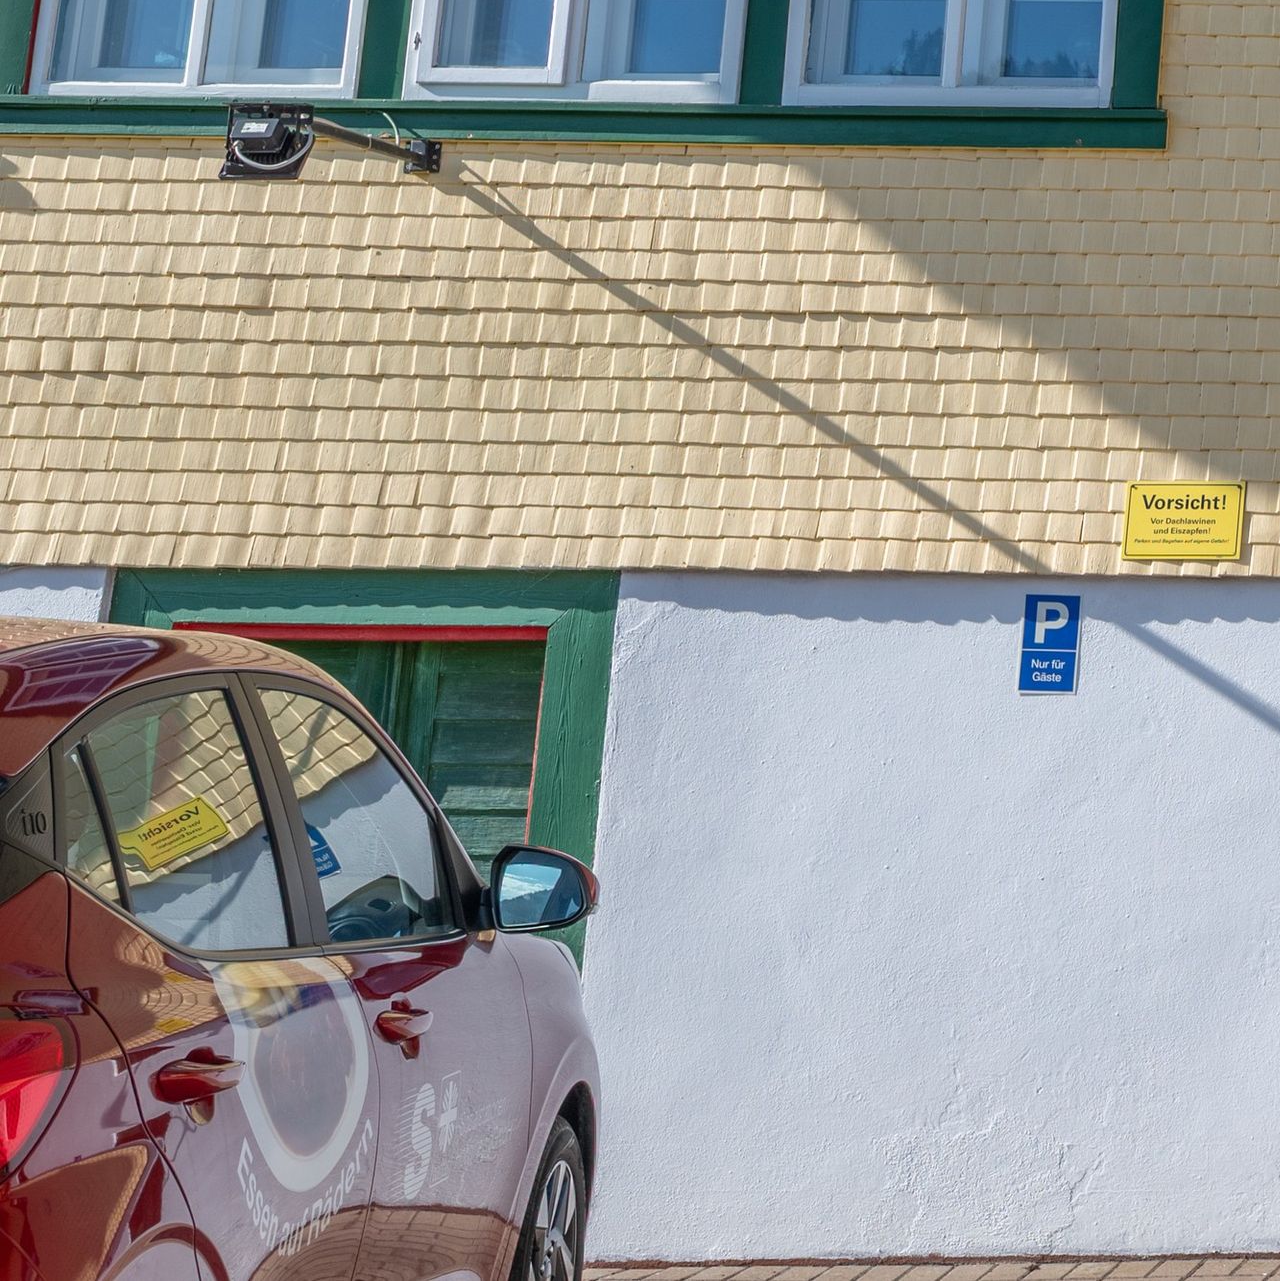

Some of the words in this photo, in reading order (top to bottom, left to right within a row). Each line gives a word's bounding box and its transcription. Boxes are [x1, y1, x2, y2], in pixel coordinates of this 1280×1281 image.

[1142, 494, 1227, 510] Vorsicht!
[1150, 517, 1164, 525] Vor
[1165, 517, 1217, 525] Dachlawinen
[1153, 527, 1169, 535] und
[1170, 527, 1212, 536] Eiszapfen!
[1033, 601, 1070, 644] P
[1031, 659, 1049, 669] Nur
[1051, 659, 1066, 669] für
[1032, 671, 1062, 682] Gäste
[21, 808, 47, 836] i10
[237, 1136, 279, 1251] Essen
[278, 1206, 310, 1256] auf
[306, 1118, 374, 1246] Rädern
